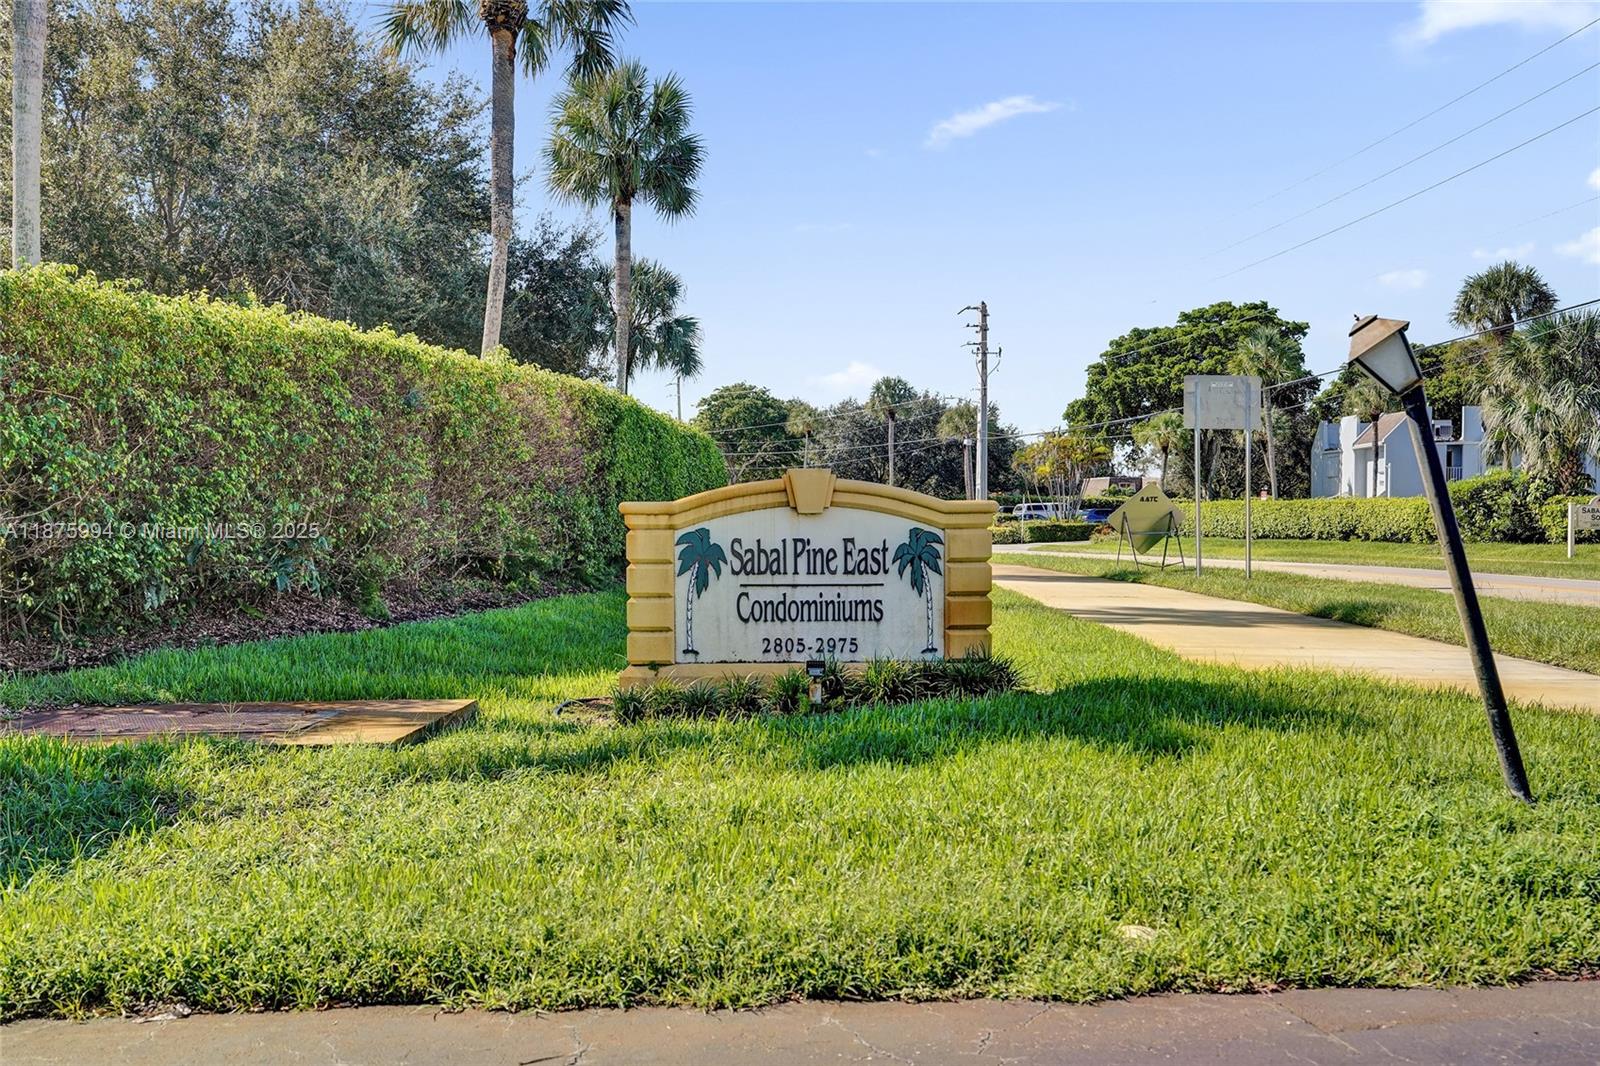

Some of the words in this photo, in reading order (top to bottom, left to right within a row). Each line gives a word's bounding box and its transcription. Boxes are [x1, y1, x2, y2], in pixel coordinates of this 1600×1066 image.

[730, 537, 788, 576] Sabal
[792, 537, 838, 576] Pine
[842, 537, 890, 576] East
[736, 591, 885, 624] Condominiums
[762, 637, 859, 654] 2805-2975
